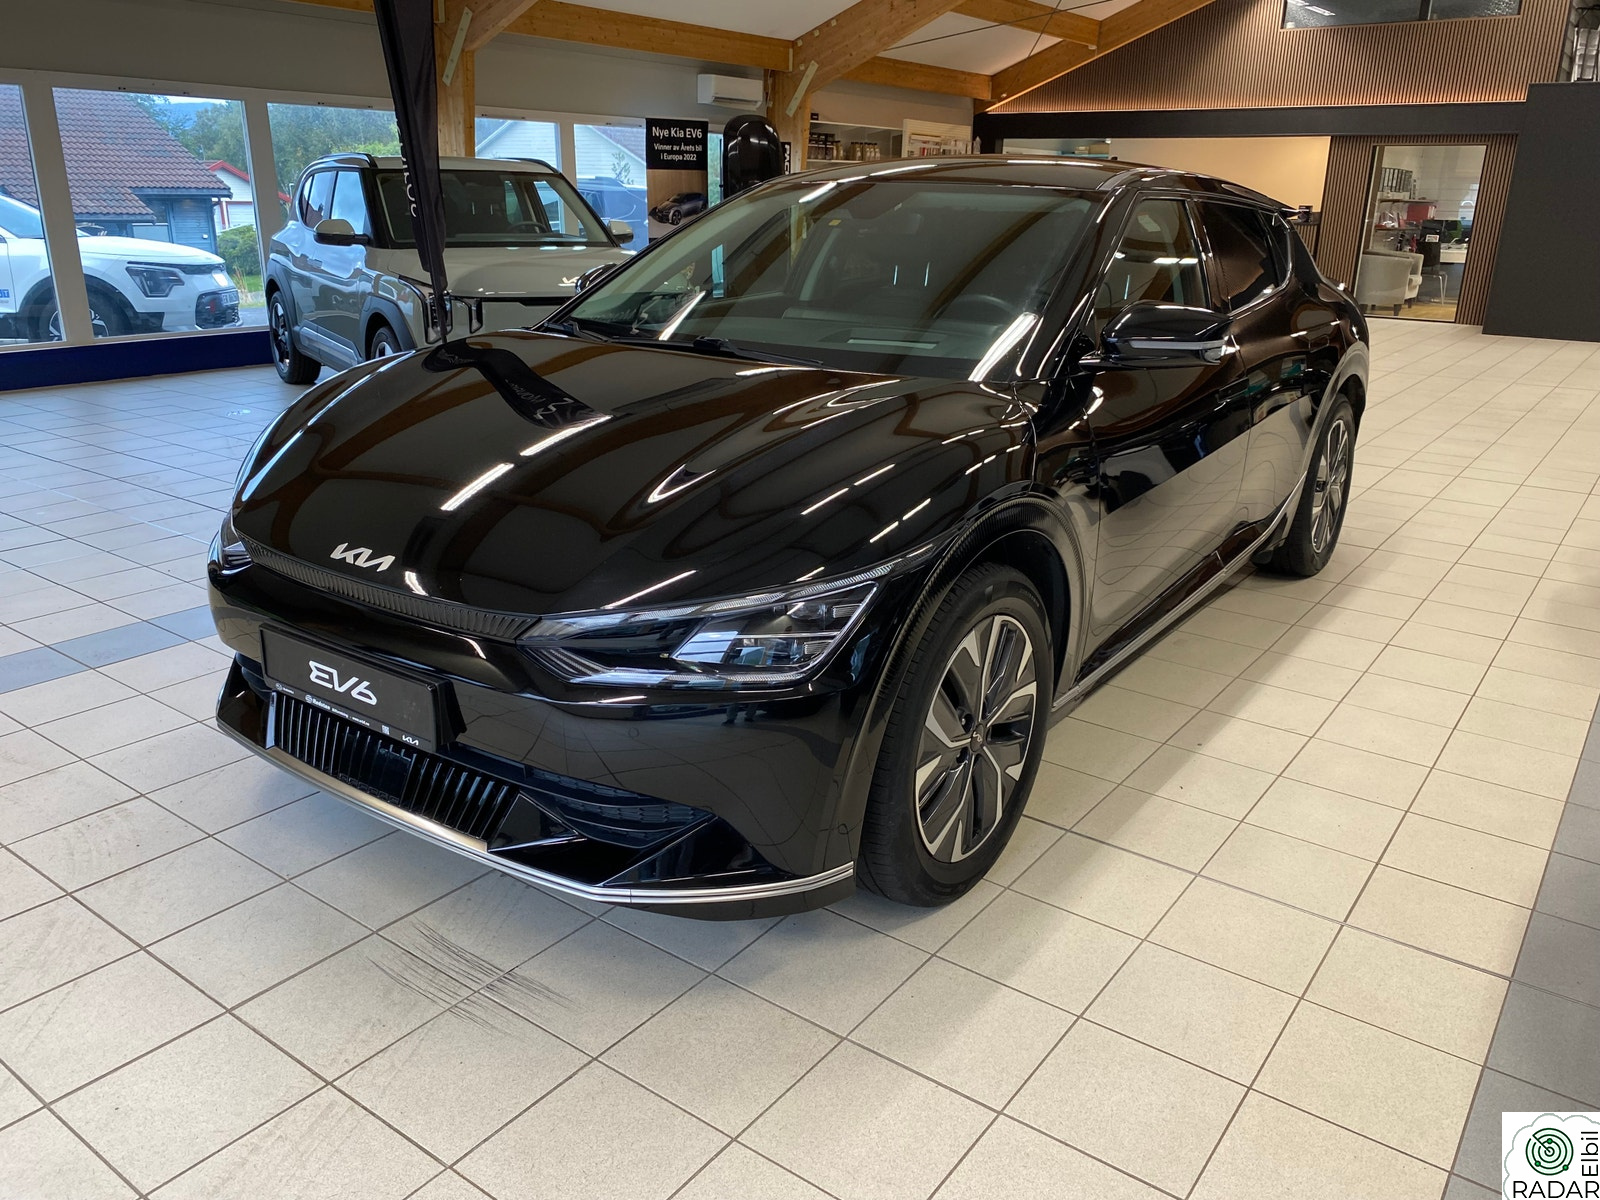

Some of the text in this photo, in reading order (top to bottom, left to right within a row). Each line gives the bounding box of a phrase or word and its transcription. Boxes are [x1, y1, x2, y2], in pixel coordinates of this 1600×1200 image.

[652, 126, 703, 139] Nye Kia EV6
[654, 143, 672, 151] Vinner
[681, 142, 695, 152] Årets
[663, 153, 683, 162] Europa
[684, 153, 697, 161] 2022
[308, 660, 378, 706] EV6
